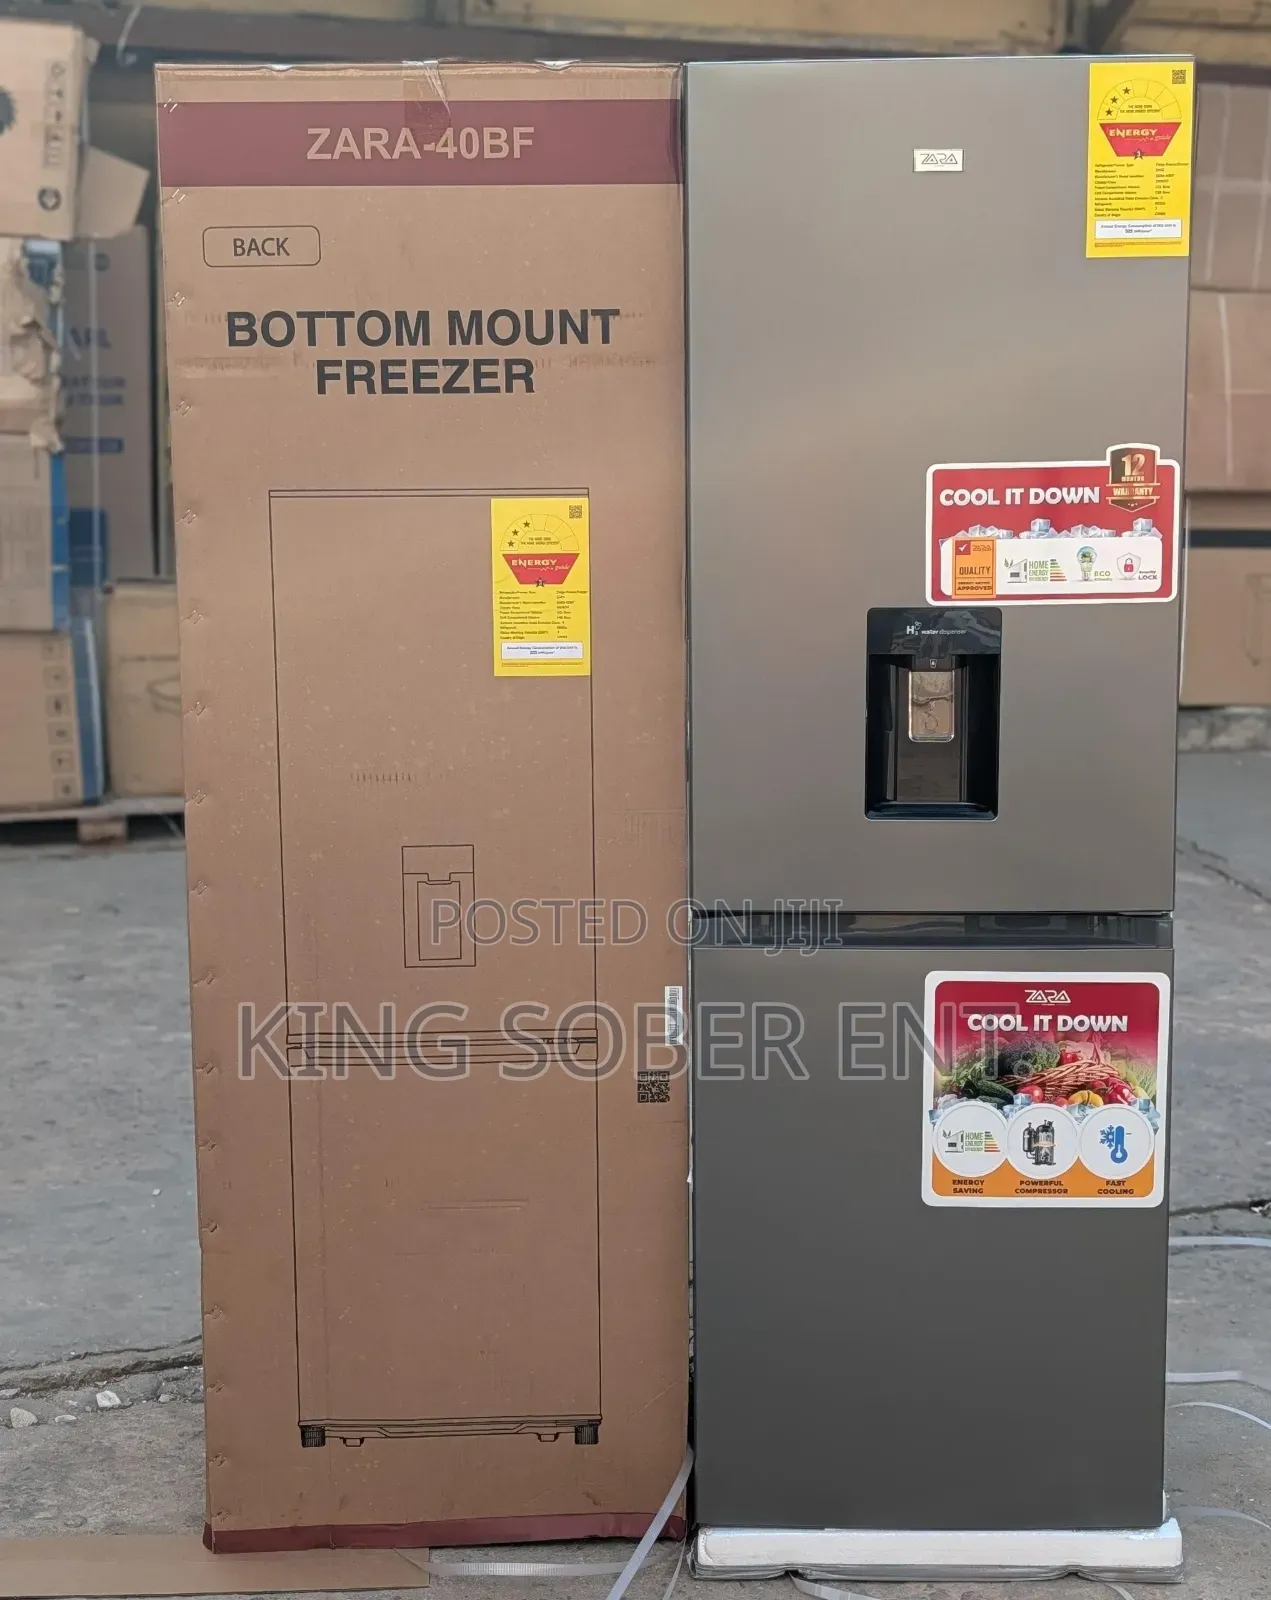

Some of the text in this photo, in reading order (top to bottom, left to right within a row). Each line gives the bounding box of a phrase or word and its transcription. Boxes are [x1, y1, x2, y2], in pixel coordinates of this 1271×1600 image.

[1109, 128, 1158, 138] ENERGY
[306, 126, 534, 161] ZARA-40BF
[920, 153, 958, 164] ZARA
[232, 236, 291, 258] BACK
[227, 308, 620, 348] BOTTOM MOUNT
[316, 358, 535, 395] FREEZER
[1122, 454, 1146, 476] 12
[939, 486, 1100, 507] COOL IT DOWN
[511, 558, 558, 568] ENERGY
[959, 566, 991, 576] QUALITY
[1029, 560, 1049, 570] HOME
[1024, 990, 1072, 1004] ZARA
[968, 1014, 1128, 1032] COOL IT DOWN
[965, 1132, 984, 1140] HOME
